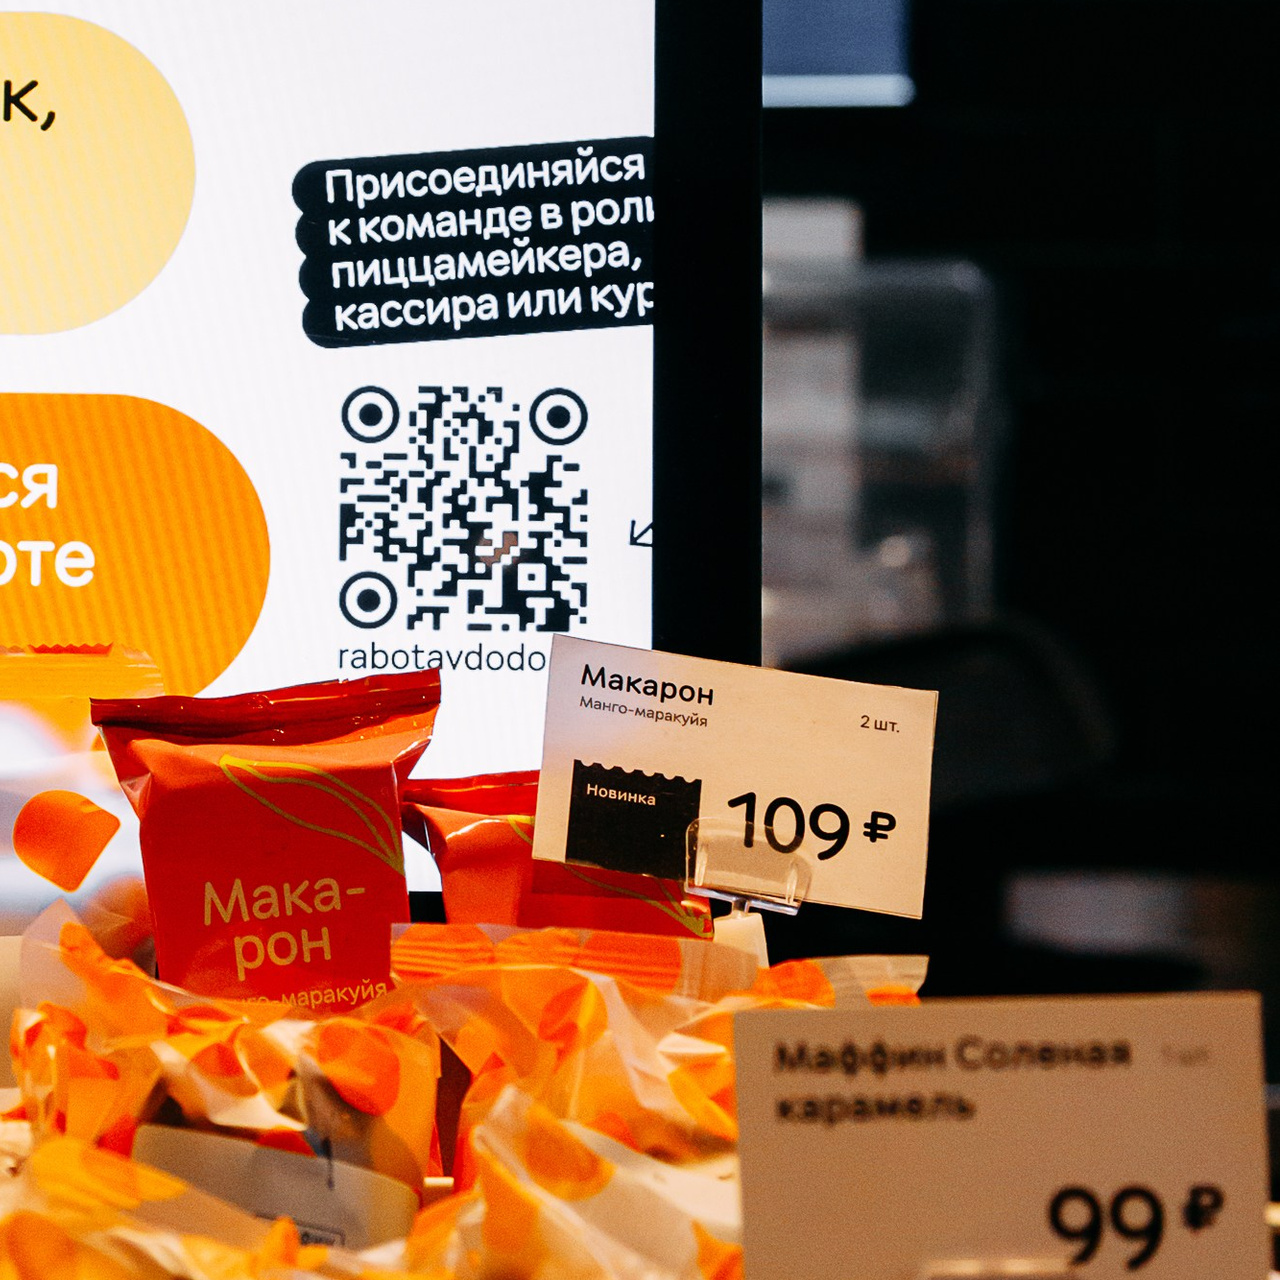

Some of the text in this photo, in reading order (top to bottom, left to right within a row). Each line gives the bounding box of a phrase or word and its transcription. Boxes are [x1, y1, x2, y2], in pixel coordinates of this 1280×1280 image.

[324, 146, 646, 208] Присоединяйся
[327, 215, 352, 246] к
[358, 203, 532, 244] команде
[540, 202, 563, 231] в
[331, 235, 642, 289] пиццамейкера,
[334, 290, 499, 332] кассира
[507, 287, 583, 318] или
[339, 641, 546, 673] rabotavdodo
[580, 663, 715, 707] Макарон
[579, 695, 901, 734] Манго-маракуйя 2 шт.
[585, 782, 657, 808] Новинка
[727, 791, 851, 861] 109
[203, 876, 366, 926] Мака-
[233, 926, 332, 981] рон
[773, 1037, 948, 1075] Маффин
[775, 1089, 977, 1125] карамель
[1047, 1182, 1164, 1271] 99
